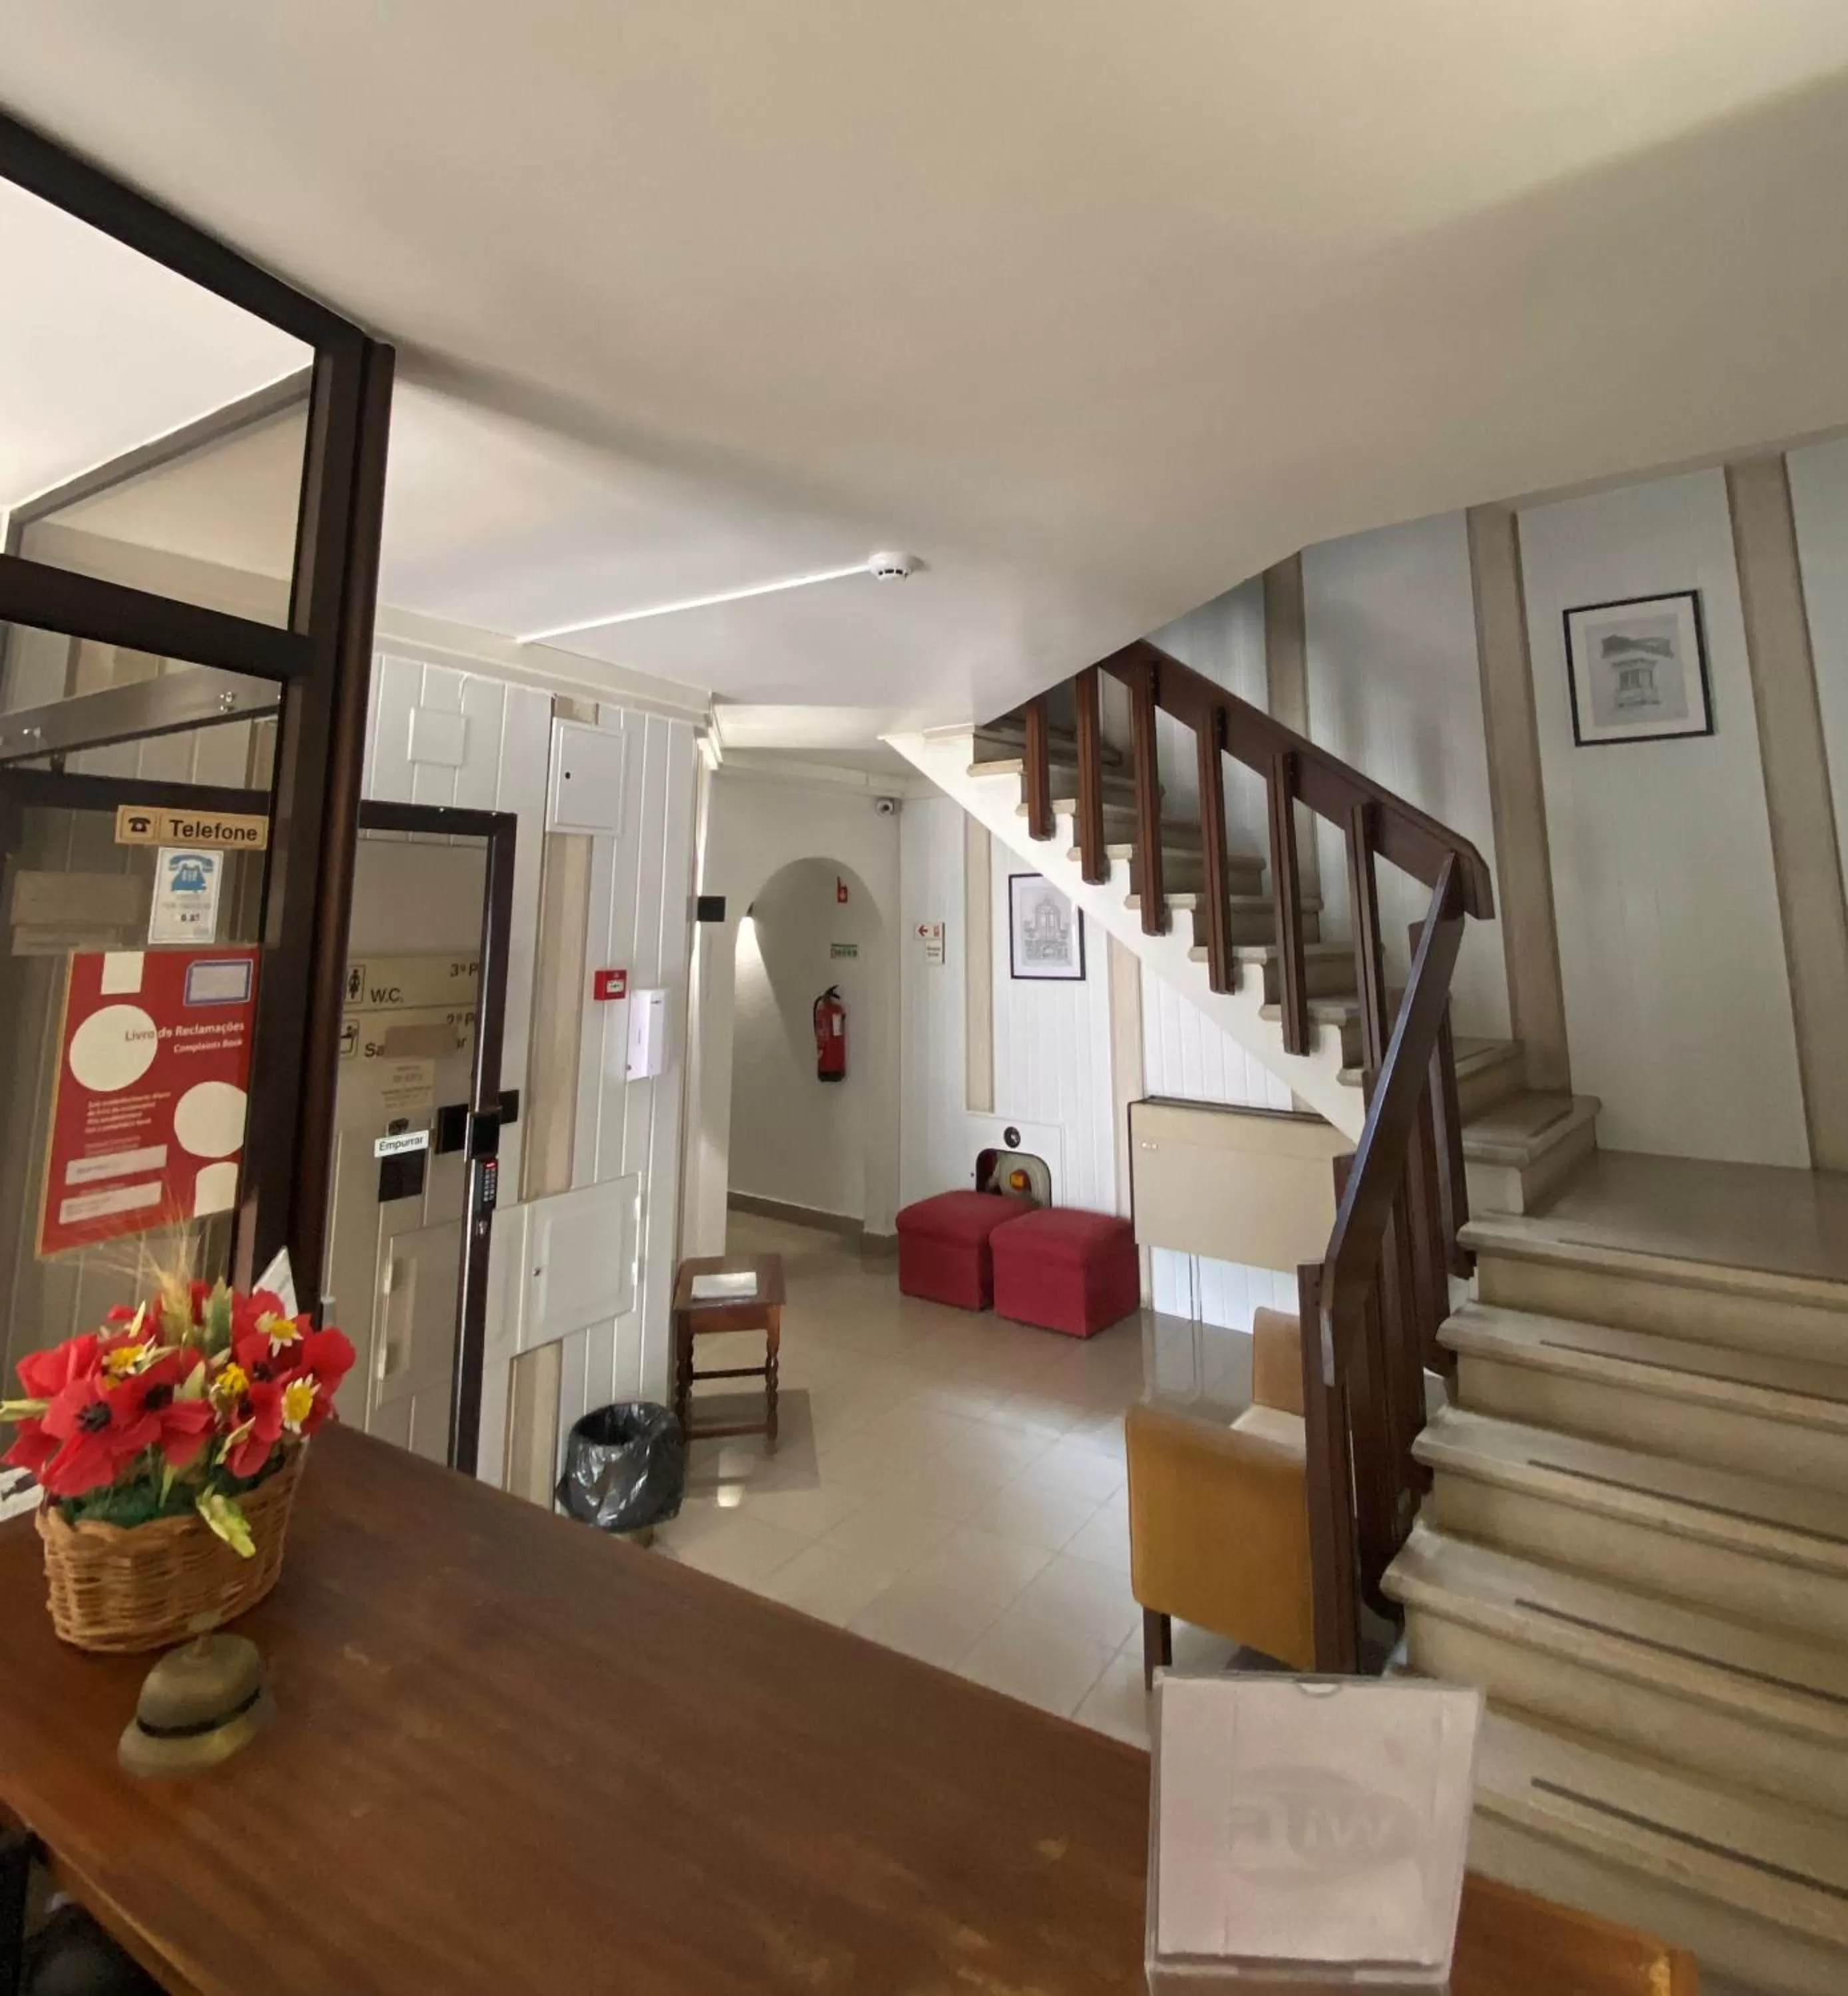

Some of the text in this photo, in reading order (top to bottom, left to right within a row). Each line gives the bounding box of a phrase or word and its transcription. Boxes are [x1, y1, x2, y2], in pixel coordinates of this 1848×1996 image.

[170, 819, 258, 841] Telefone
[371, 987, 403, 1003] W.C.
[125, 1022, 244, 1042] Livro de Reclamações
[379, 1136, 424, 1152] Empurrar
